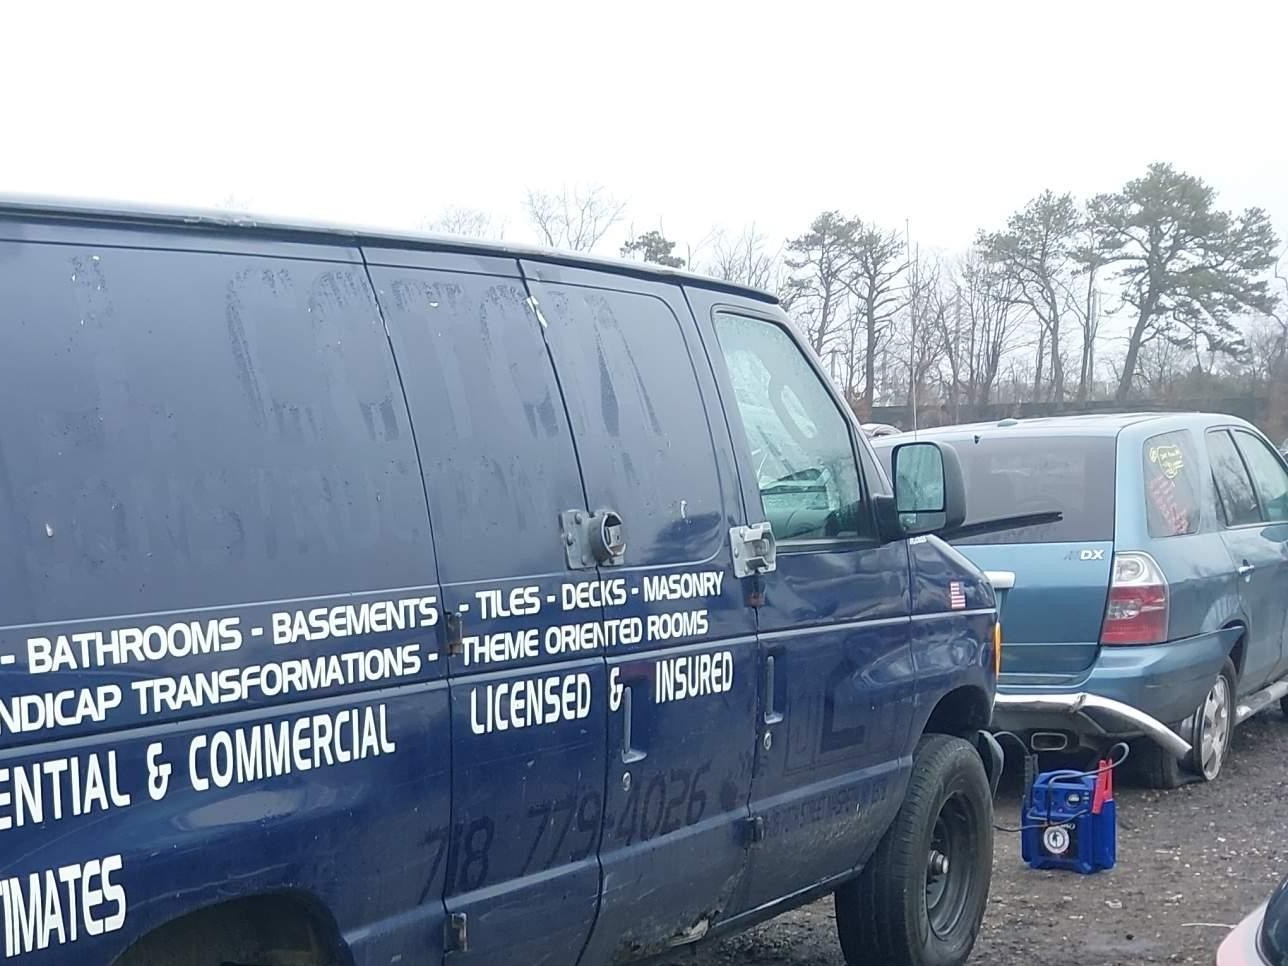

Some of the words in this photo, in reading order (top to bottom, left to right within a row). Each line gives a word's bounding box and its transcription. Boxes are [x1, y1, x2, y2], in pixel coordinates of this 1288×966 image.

[28, 617, 243, 675] BATHROOMS
[273, 597, 438, 645] BASEMENTS
[475, 586, 541, 621] TILES
[561, 579, 627, 611] DECKS
[643, 571, 724, 602] MASONRY
[132, 645, 421, 715] TRANSFORMATIONS
[462, 629, 539, 667] THEME
[545, 618, 643, 654] ORIENTED
[648, 609, 709, 641] ROOMS
[470, 673, 592, 735] LICENSED
[609, 667, 624, 711] &
[655, 651, 734, 704] INSURED
[147, 743, 172, 800] &
[189, 704, 396, 792] COMMERCIAL
